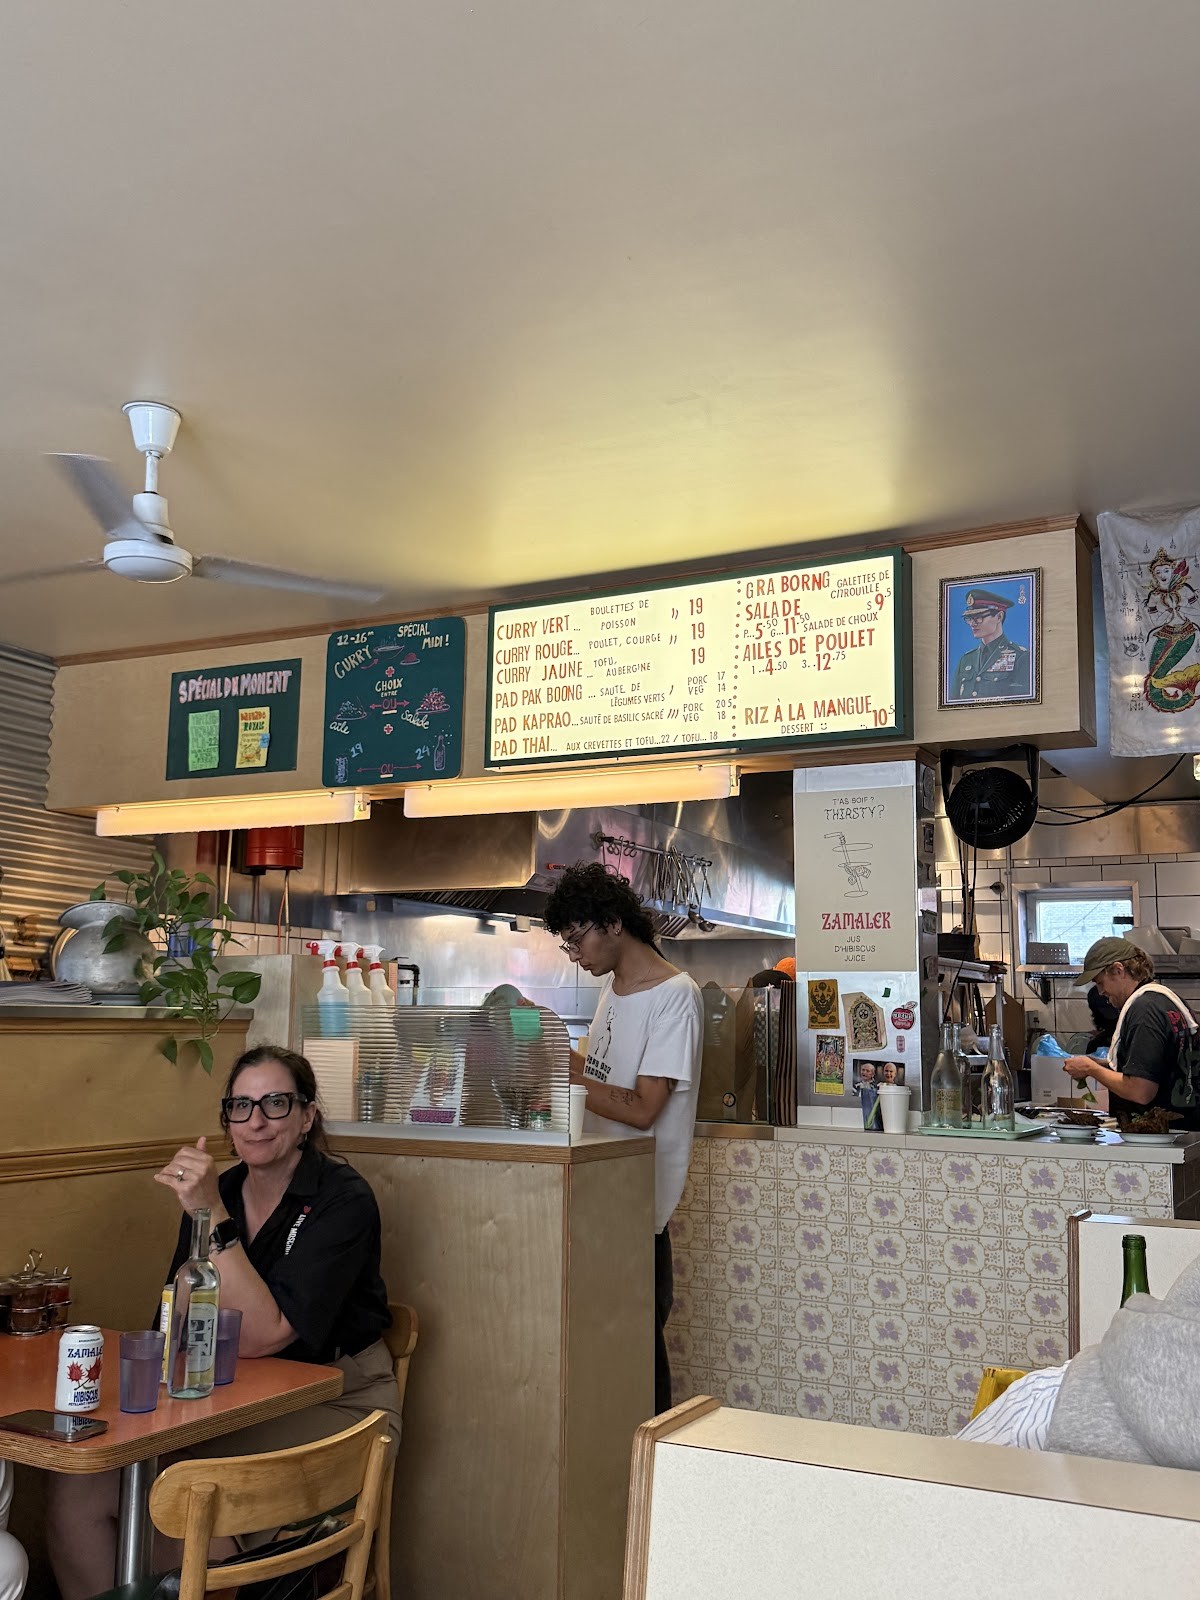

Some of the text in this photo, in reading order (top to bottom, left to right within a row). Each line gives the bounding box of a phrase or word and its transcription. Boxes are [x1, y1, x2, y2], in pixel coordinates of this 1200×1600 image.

[746, 571, 830, 598] GRA BORNG
[837, 570, 889, 588] GALETTES DE
[590, 600, 649, 615] BOULETTES DE
[689, 598, 703, 615] 19
[746, 599, 801, 620] SALADE
[397, 622, 430, 638] SPÉCIAL
[601, 618, 636, 630] POISSON
[804, 612, 878, 632] SALADE DE CHOUX
[497, 621, 537, 640] CURRY
[691, 622, 705, 640] 19
[422, 636, 443, 649] MIDI
[626, 634, 661, 644] COURGE
[743, 628, 875, 661] AILES DE POULET
[334, 645, 372, 678] CURRY
[496, 646, 530, 665] CURRY
[691, 647, 705, 665] 19
[497, 661, 583, 684] CURRY JAUNE
[606, 662, 651, 677] AUBERGINE
[376, 678, 403, 692] CHOIX
[688, 671, 726, 686] PORC 17
[179, 675, 222, 704] SPÉCIAL
[240, 670, 292, 696] MOMENT
[631, 683, 640, 692] DE
[688, 683, 725, 695] VEG 14
[382, 699, 396, 709] OU
[496, 685, 582, 709] PAD PAK BOONG
[644, 692, 665, 703] VERTS
[684, 703, 704, 712] PORC
[744, 695, 872, 725] RIZ À LA MANGUE
[495, 716, 517, 734] PAD
[604, 714, 612, 724] DE
[614, 712, 640, 722] BASILIC
[641, 709, 664, 721] SACRÉ
[683, 711, 726, 722] VEG 18
[873, 708, 887, 727] 10
[781, 723, 814, 734] DESSERT
[350, 742, 363, 758] 19
[494, 740, 517, 756] PAD
[566, 742, 580, 751] AUX
[584, 739, 622, 750] CREVETTES
[625, 738, 632, 747] ET
[710, 731, 718, 741] 18
[416, 746, 429, 760] 24
[380, 764, 393, 774] OU
[824, 804, 884, 820] THIRSTY?
[822, 912, 891, 930] ZAMALEK
[74, 1390, 98, 1402] HIBISCUS
